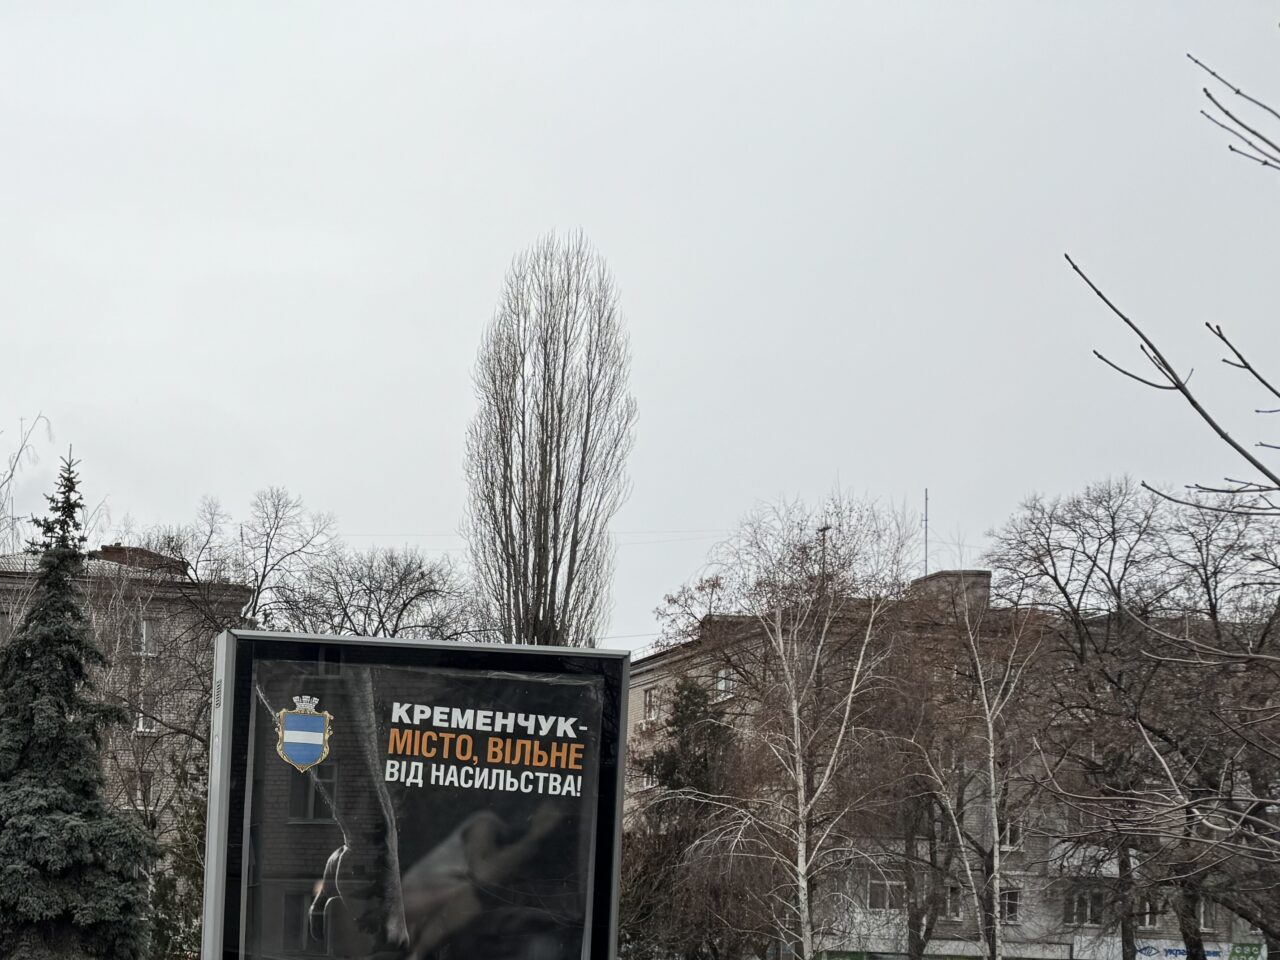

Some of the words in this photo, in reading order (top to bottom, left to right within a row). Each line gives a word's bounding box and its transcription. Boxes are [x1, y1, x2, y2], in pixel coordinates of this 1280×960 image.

[391, 702, 588, 738] КРЕМЕНЧУК-
[388, 728, 479, 766] МІСТО,
[487, 738, 585, 770] ВІЛЬНЕ
[385, 760, 423, 787] ВІД
[431, 762, 582, 797] НАСИЛЬСТВА!
